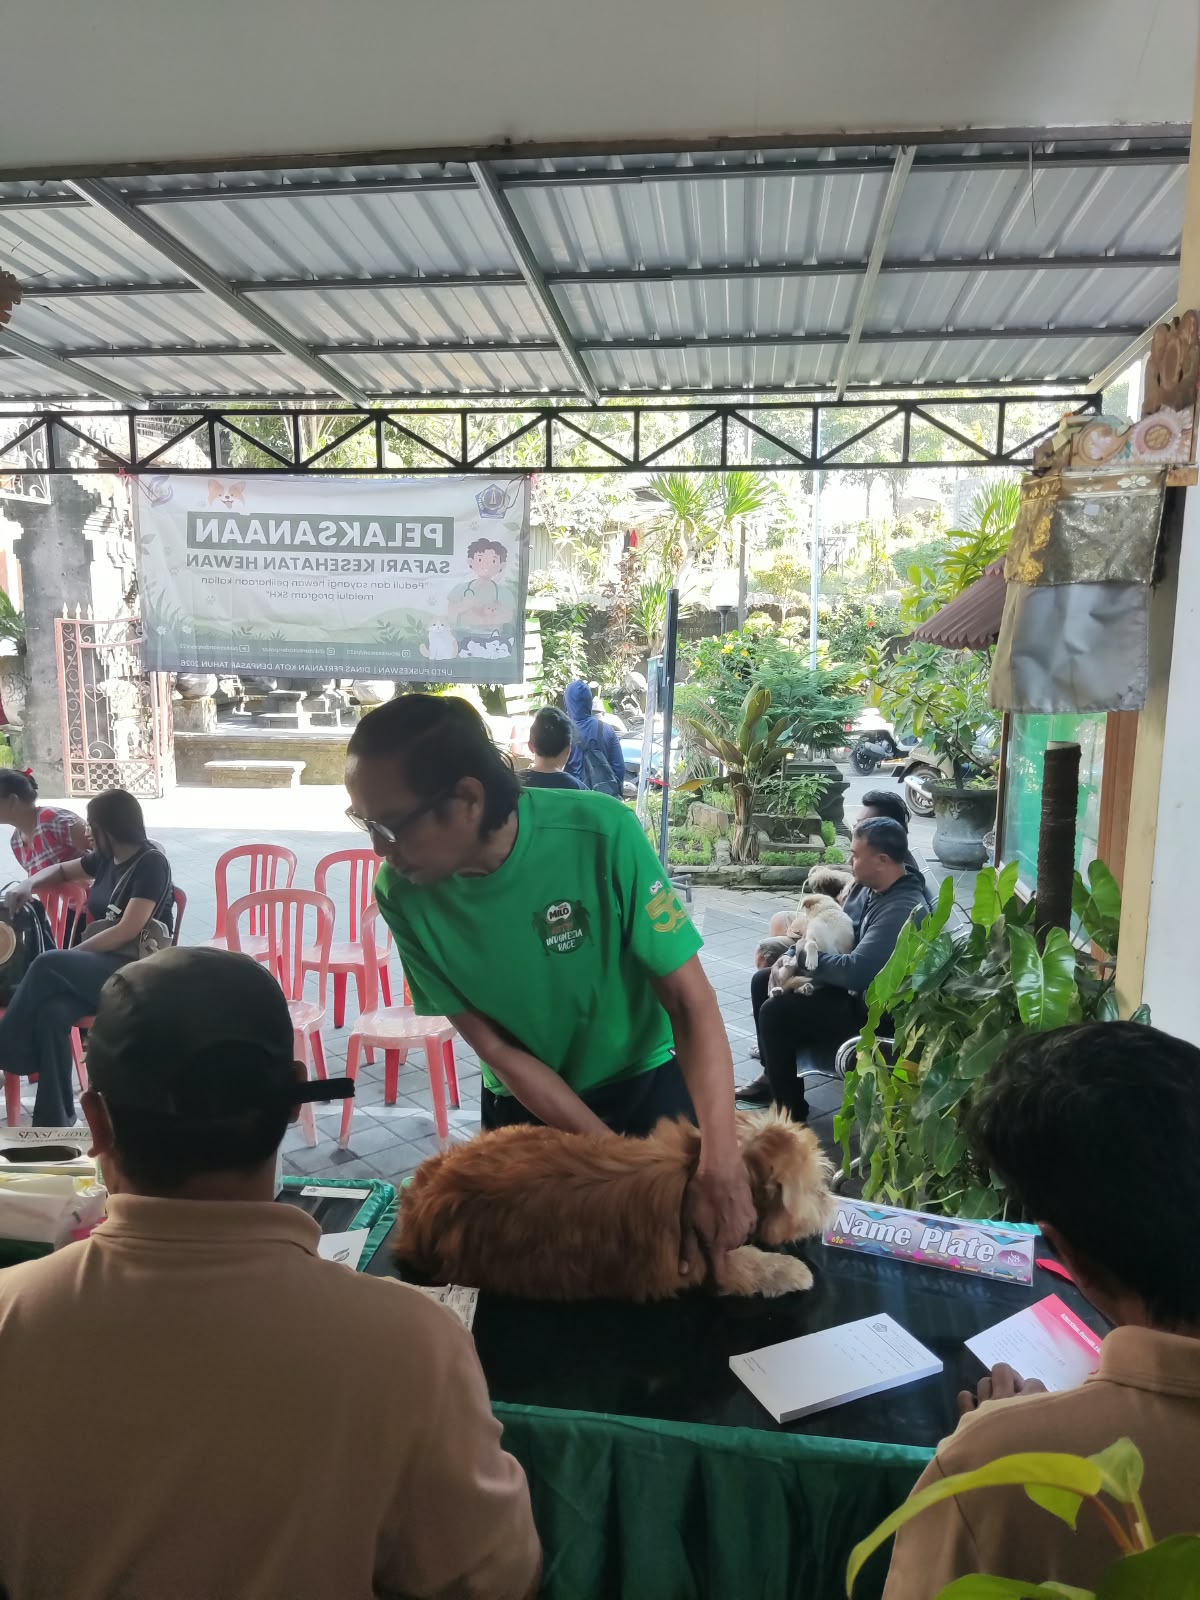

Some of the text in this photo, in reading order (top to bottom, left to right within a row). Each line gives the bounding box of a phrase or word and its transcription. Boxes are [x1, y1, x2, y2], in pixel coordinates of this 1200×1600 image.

[549, 907, 570, 920] MILO
[557, 939, 576, 951] RACE
[833, 1209, 995, 1262] Name Plate
